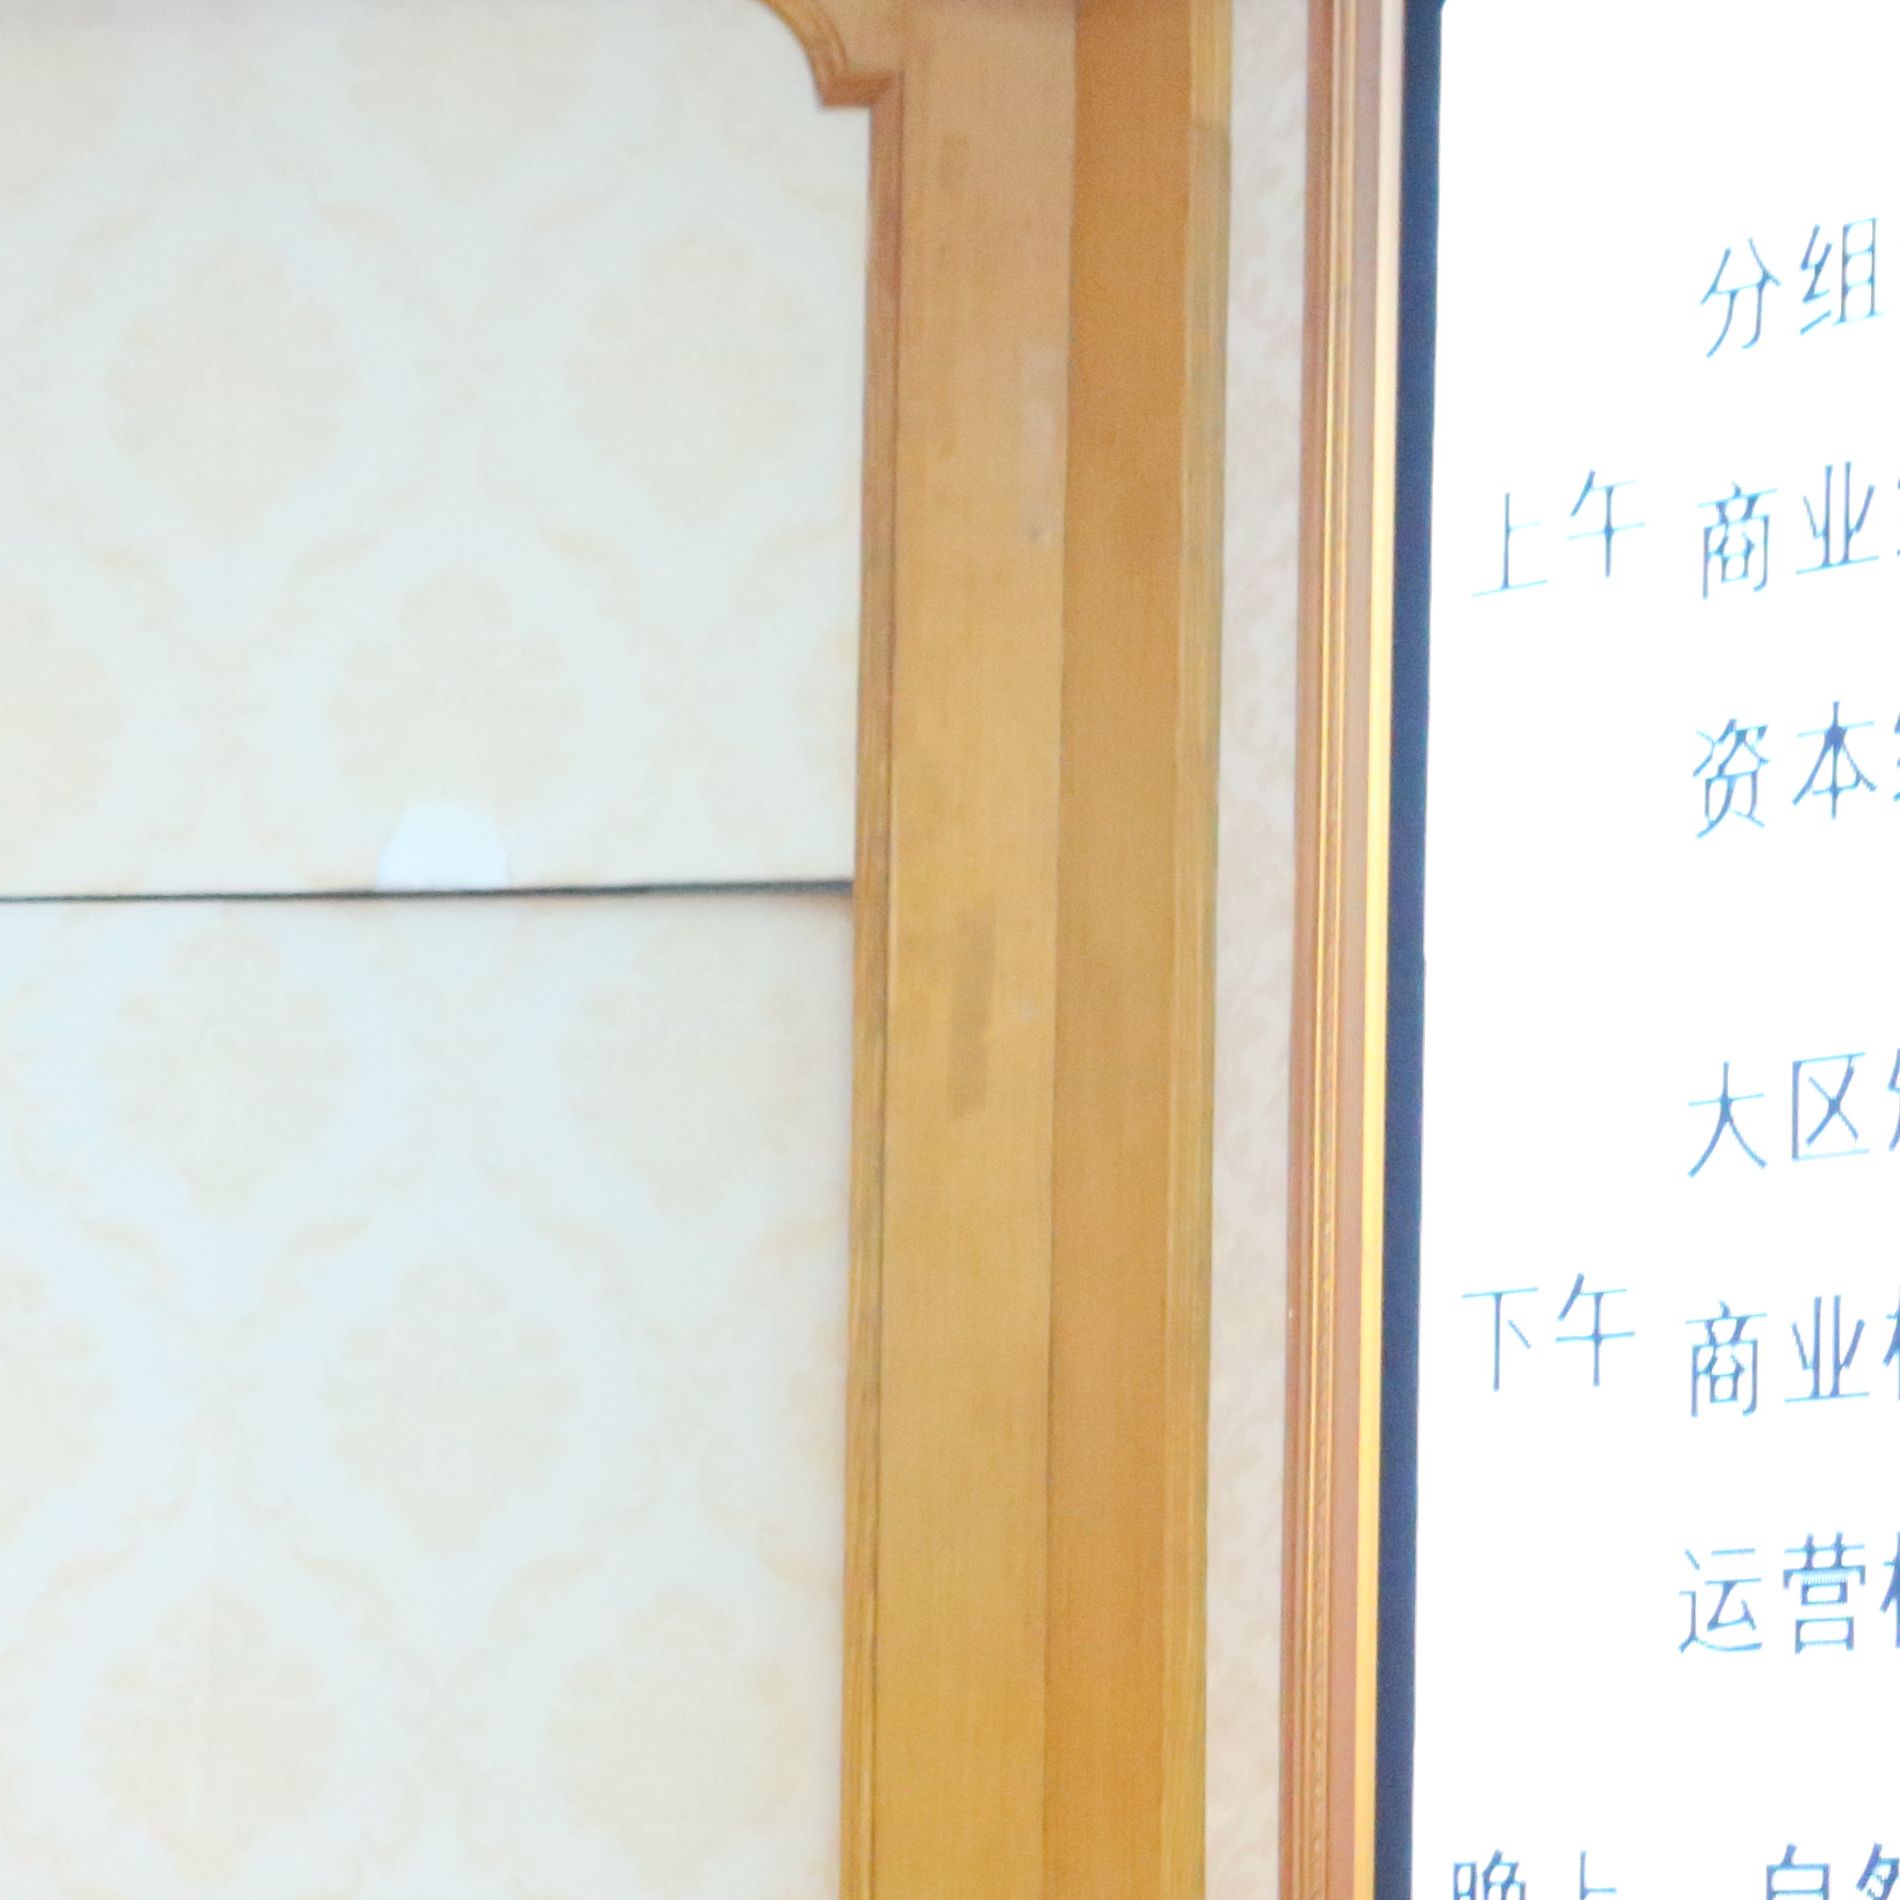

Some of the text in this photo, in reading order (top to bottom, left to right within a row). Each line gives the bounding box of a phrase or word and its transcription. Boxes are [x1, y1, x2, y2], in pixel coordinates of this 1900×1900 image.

[1700, 217, 1880, 358] 分组
[1471, 461, 1900, 600] 上午 商业
[1692, 700, 1900, 839] 资本
[1689, 1048, 1900, 1178] 大区
[1461, 1273, 1900, 1418] 下午 商业
[1678, 1530, 1900, 1655] 运营
